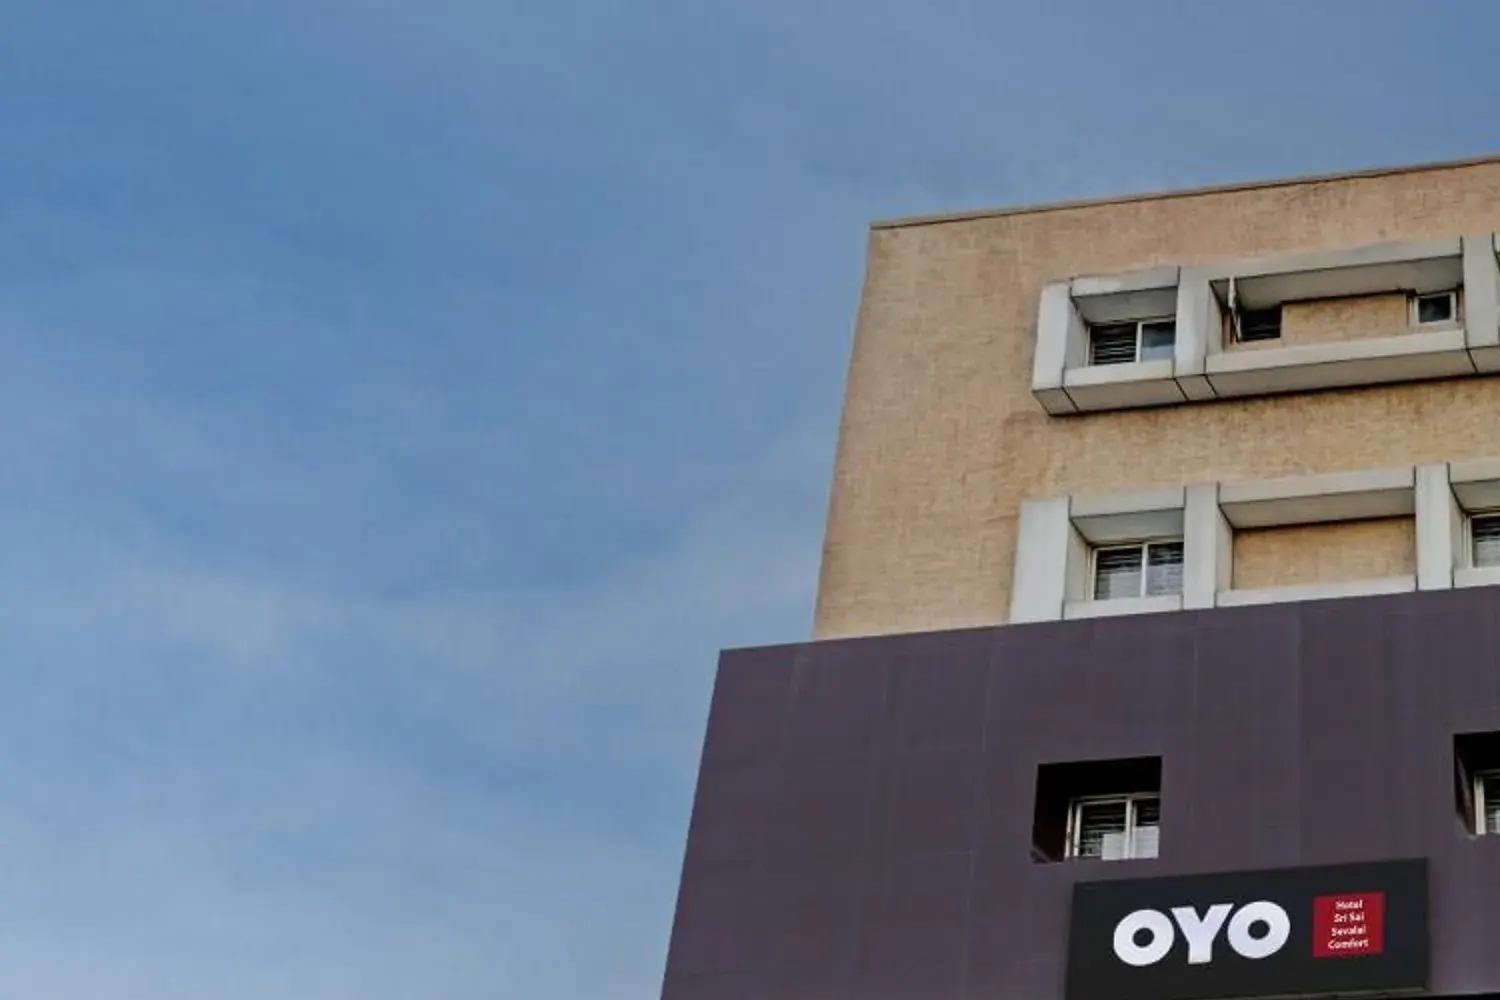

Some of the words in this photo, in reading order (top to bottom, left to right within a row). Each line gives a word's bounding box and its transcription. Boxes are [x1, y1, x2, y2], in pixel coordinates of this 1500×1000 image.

[1335, 899, 1363, 910] Hotel
[1334, 913, 1347, 923] Sri
[1350, 911, 1365, 922] Sai
[1113, 899, 1291, 967] OYO
[1328, 937, 1369, 950] Comfort
